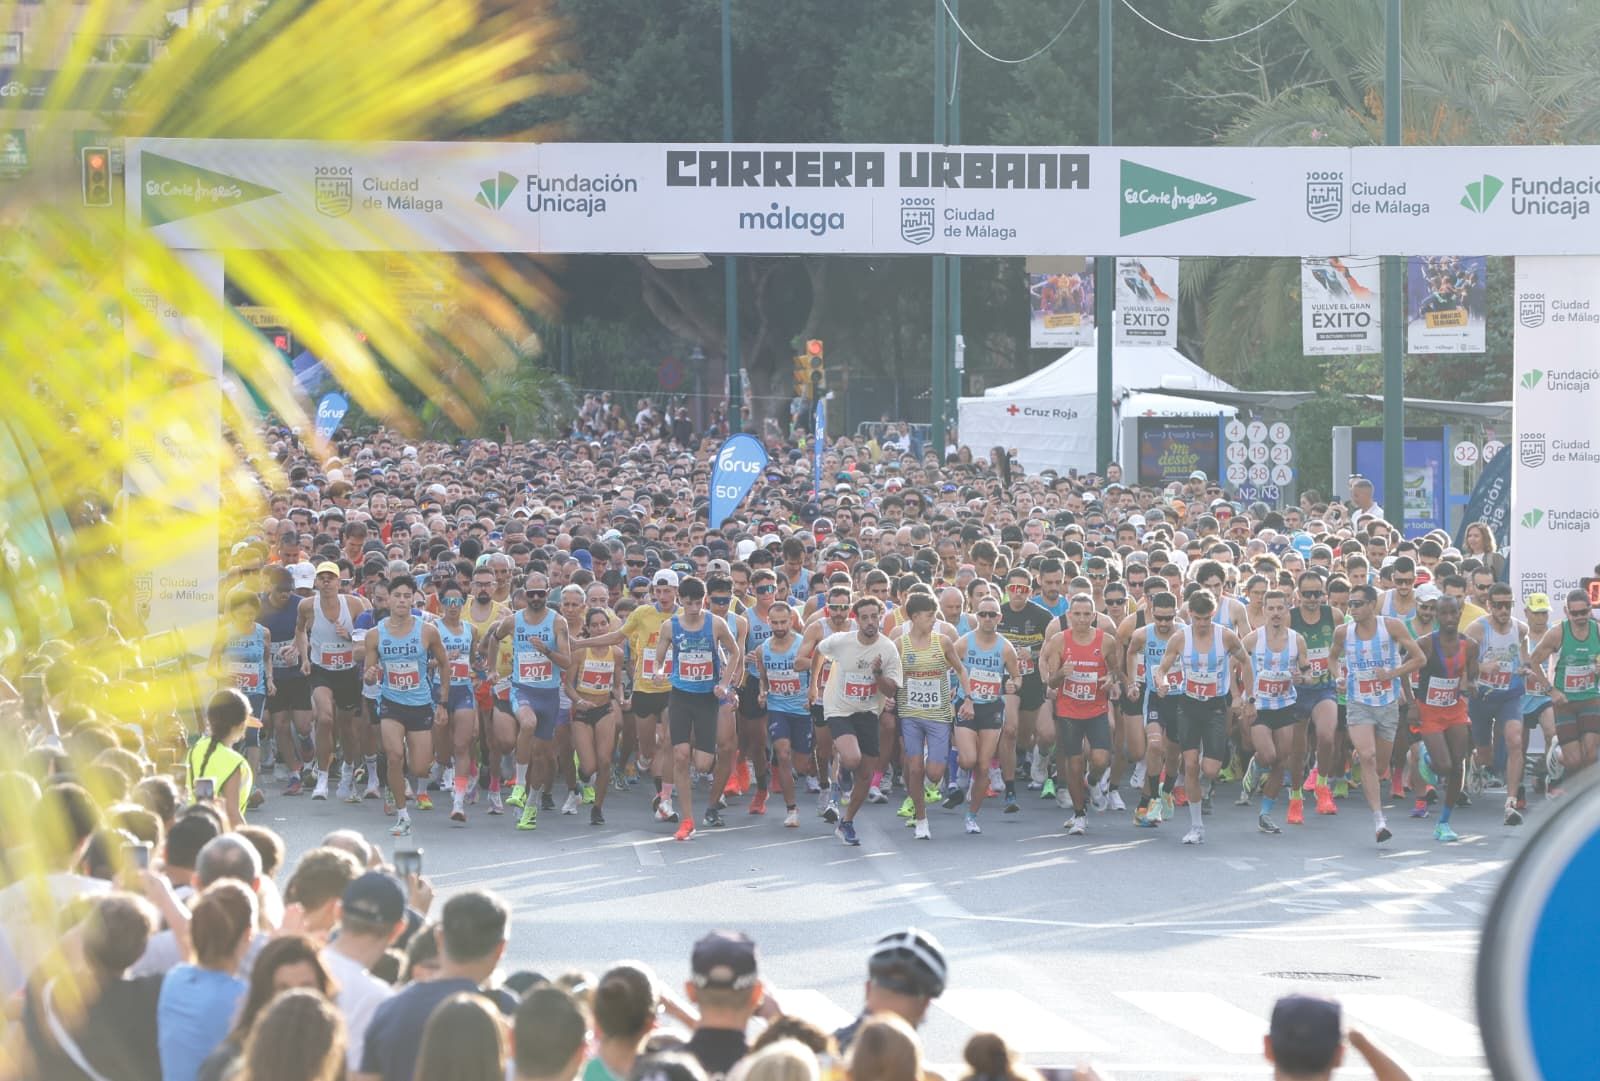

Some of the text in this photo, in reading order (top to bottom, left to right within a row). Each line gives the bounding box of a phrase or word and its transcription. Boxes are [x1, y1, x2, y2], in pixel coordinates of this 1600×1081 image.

[667, 151, 1090, 188] CARRERA URBANA
[362, 178, 420, 191] Ciudad
[527, 174, 637, 193] Fundación
[1351, 182, 1407, 196] Ciudad
[1124, 189, 1139, 205] El
[1139, 190, 1172, 206] Corte
[362, 197, 445, 212] de Málaga
[527, 195, 607, 218] Unicaja
[1351, 200, 1430, 216] de Málaga
[1511, 196, 1590, 221] Unicaja
[944, 208, 994, 221] Ciudad
[944, 225, 1017, 242] de Málaga
[1311, 303, 1338, 311] VUELVE
[1552, 299, 1590, 310] Ciudad
[1123, 311, 1170, 327] ÉXITO
[1312, 310, 1371, 328] ÉXITO
[1552, 312, 1566, 322] de
[1547, 380, 1590, 393] Unicaja
[1023, 407, 1078, 420] Cruz Roja
[1231, 425, 1239, 438] 4
[1252, 425, 1260, 438] 7
[1276, 426, 1285, 439] 8
[1552, 439, 1590, 450] Ciudad
[1230, 446, 1246, 459] 14
[1252, 447, 1266, 460] 19
[1274, 447, 1290, 460] 21
[1456, 446, 1477, 461] 32
[1552, 452, 1566, 462] de
[1230, 467, 1246, 480] 23
[1250, 467, 1267, 481] 38
[1276, 468, 1287, 481] A
[1240, 487, 1257, 500] N2
[1261, 485, 1280, 500] N3
[1548, 519, 1591, 533] Unicaja
[1553, 579, 1578, 590] Ciud
[176, 589, 215, 602] Málaga
[383, 642, 417, 656] nerja
[330, 656, 345, 665] 58
[967, 654, 999, 669] nerja
[525, 666, 546, 678] 207
[686, 665, 707, 676] 107
[394, 675, 414, 687] 190
[774, 681, 796, 693] 206
[974, 683, 995, 695] 264
[1195, 684, 1208, 696] 17
[910, 691, 939, 703] 2236
